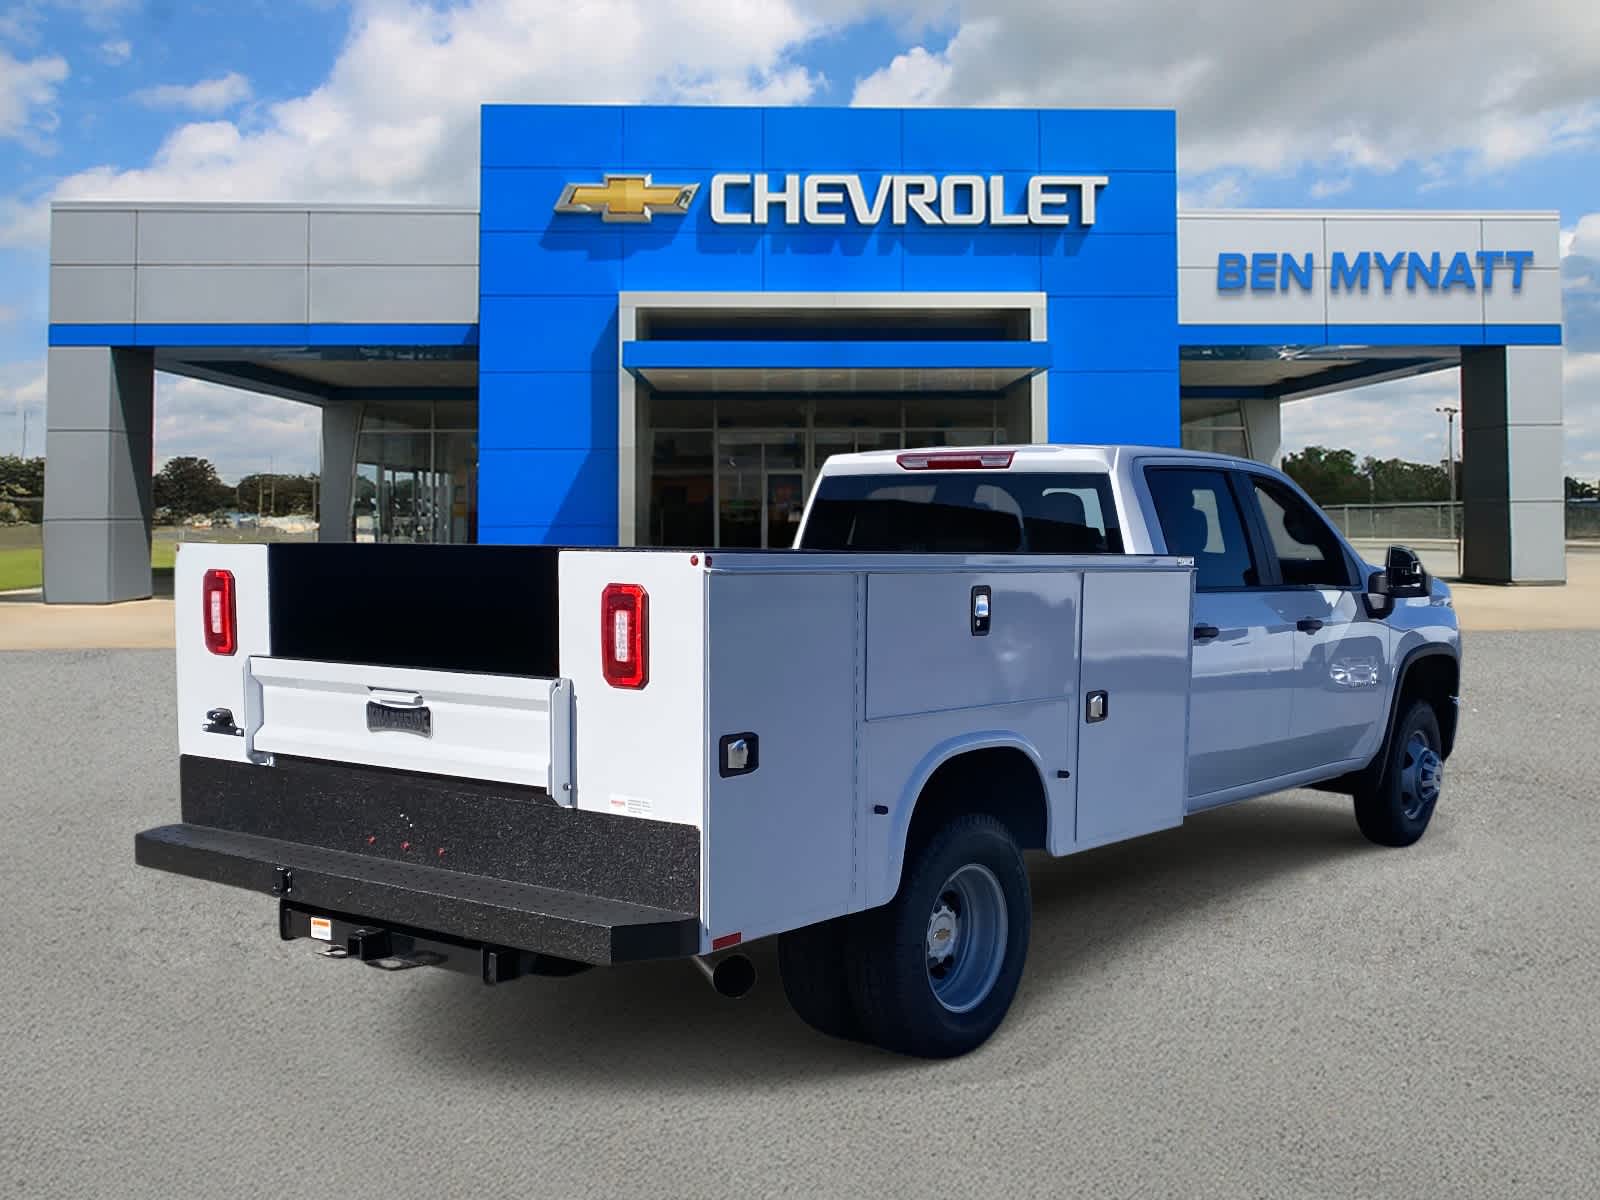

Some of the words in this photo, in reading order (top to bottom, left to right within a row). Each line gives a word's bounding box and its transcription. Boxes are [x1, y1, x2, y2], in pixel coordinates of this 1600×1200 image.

[710, 174, 1109, 226] CHEVROLET
[1217, 252, 1314, 291] BEN
[1330, 250, 1534, 291] MYNATT
